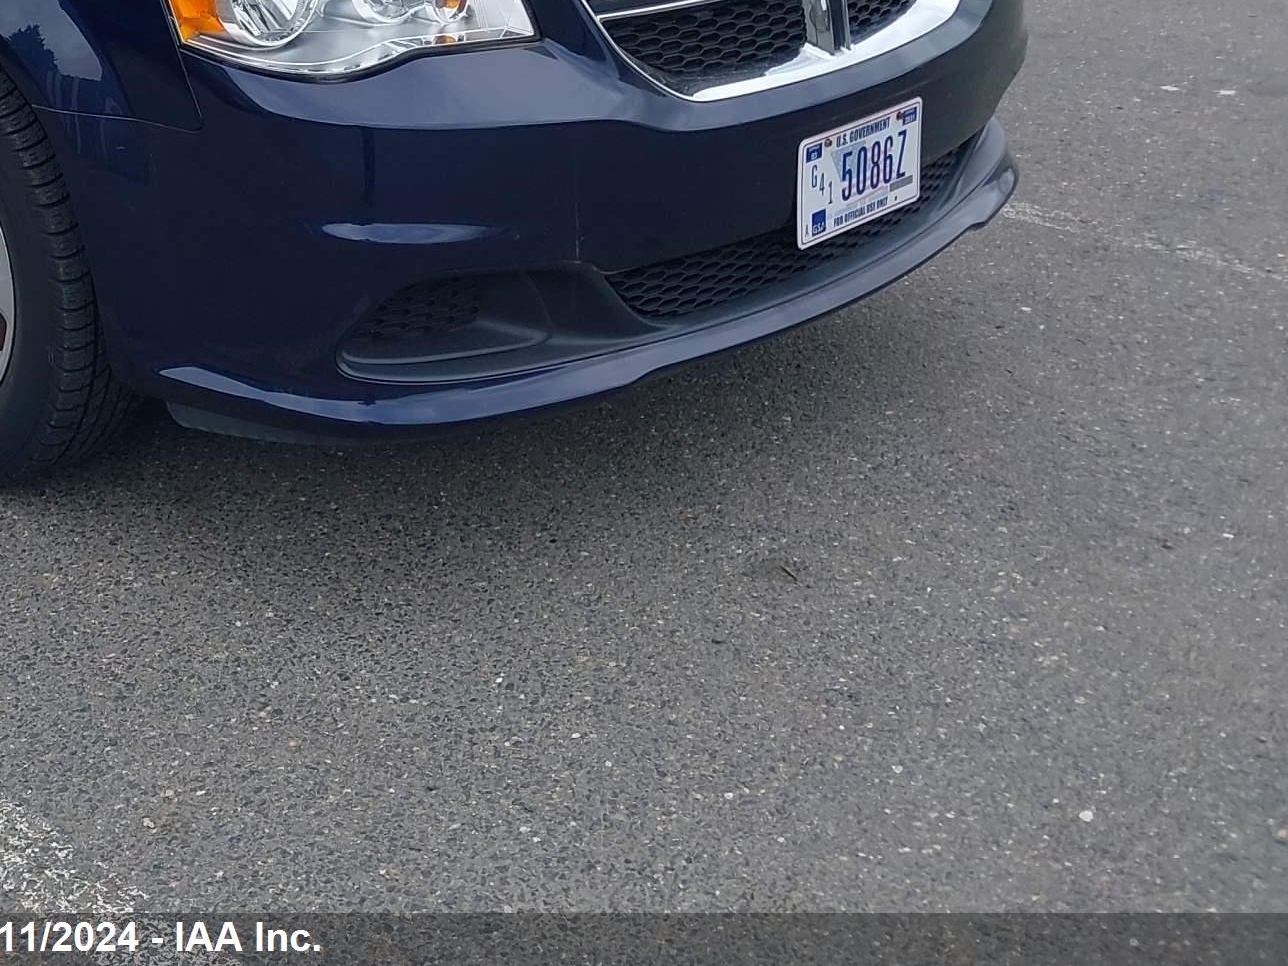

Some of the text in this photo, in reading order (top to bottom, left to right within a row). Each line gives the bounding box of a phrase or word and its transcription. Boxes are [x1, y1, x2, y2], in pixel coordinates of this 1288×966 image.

[836, 135, 848, 147] U.S.
[849, 117, 891, 144] GOVERNMENT
[841, 129, 907, 201] 5086Z
